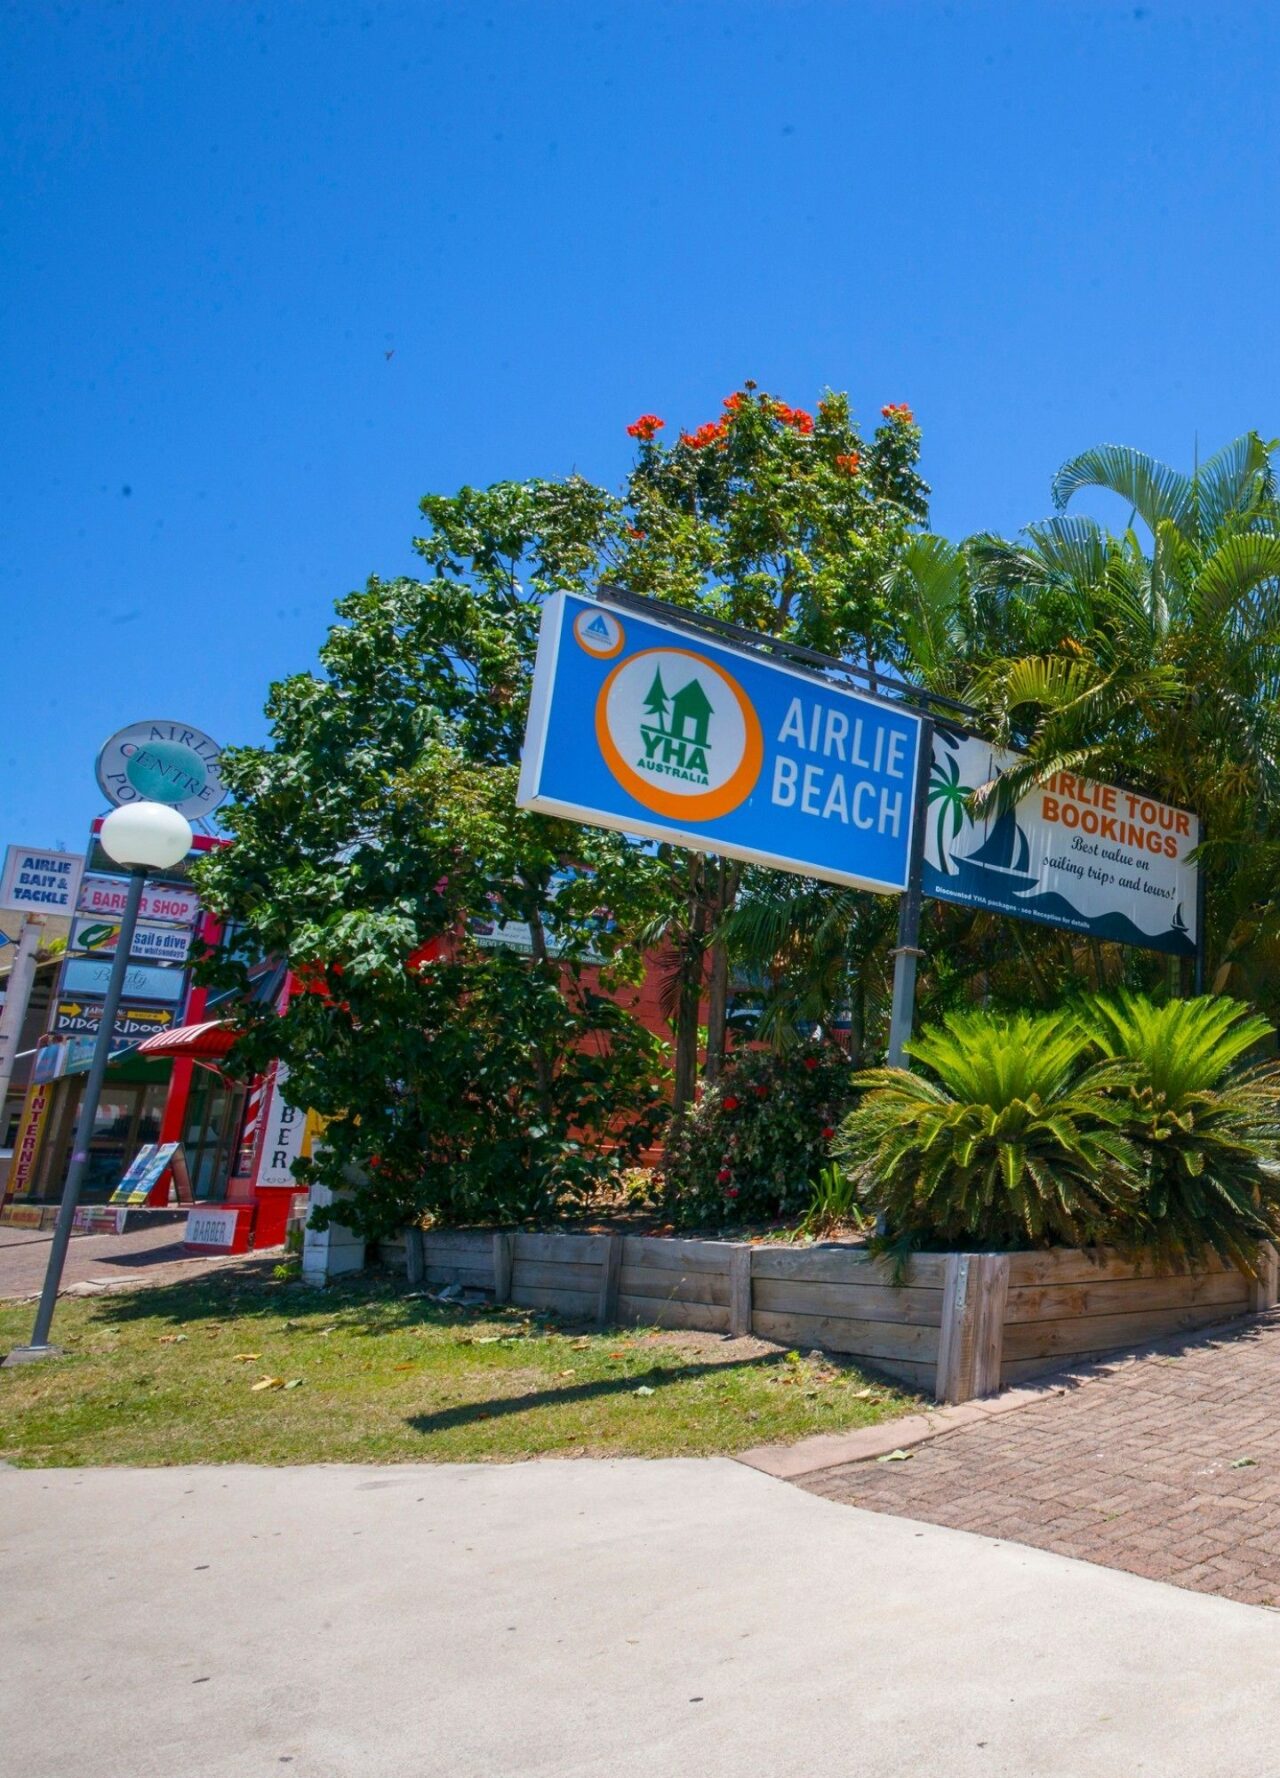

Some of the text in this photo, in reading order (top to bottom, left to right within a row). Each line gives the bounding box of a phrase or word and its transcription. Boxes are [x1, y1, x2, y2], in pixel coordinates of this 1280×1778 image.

[149, 725, 221, 775] AIRLIE
[640, 729, 709, 775] YHA
[777, 696, 908, 780] AIRLIE
[120, 743, 215, 802] CENTRE
[637, 758, 709, 787] AUSTRALIA
[771, 755, 903, 839] BEACH
[1040, 770, 1190, 837] IRLIE TOUR
[1041, 796, 1178, 859] BOOKINGS
[22, 857, 72, 875] AIRLIE
[1071, 835, 1149, 871] Best value on
[14, 887, 69, 905] TACKLE
[19, 872, 68, 890] BAIT &
[1042, 855, 1177, 900] sailing trips and tours!
[91, 891, 189, 917] BARBR SHOP
[131, 944, 142, 953] the
[134, 932, 155, 946] sail
[163, 934, 187, 950] dive
[15, 1084, 46, 1190] INTERNET
[192, 1220, 227, 1243] BARBER
